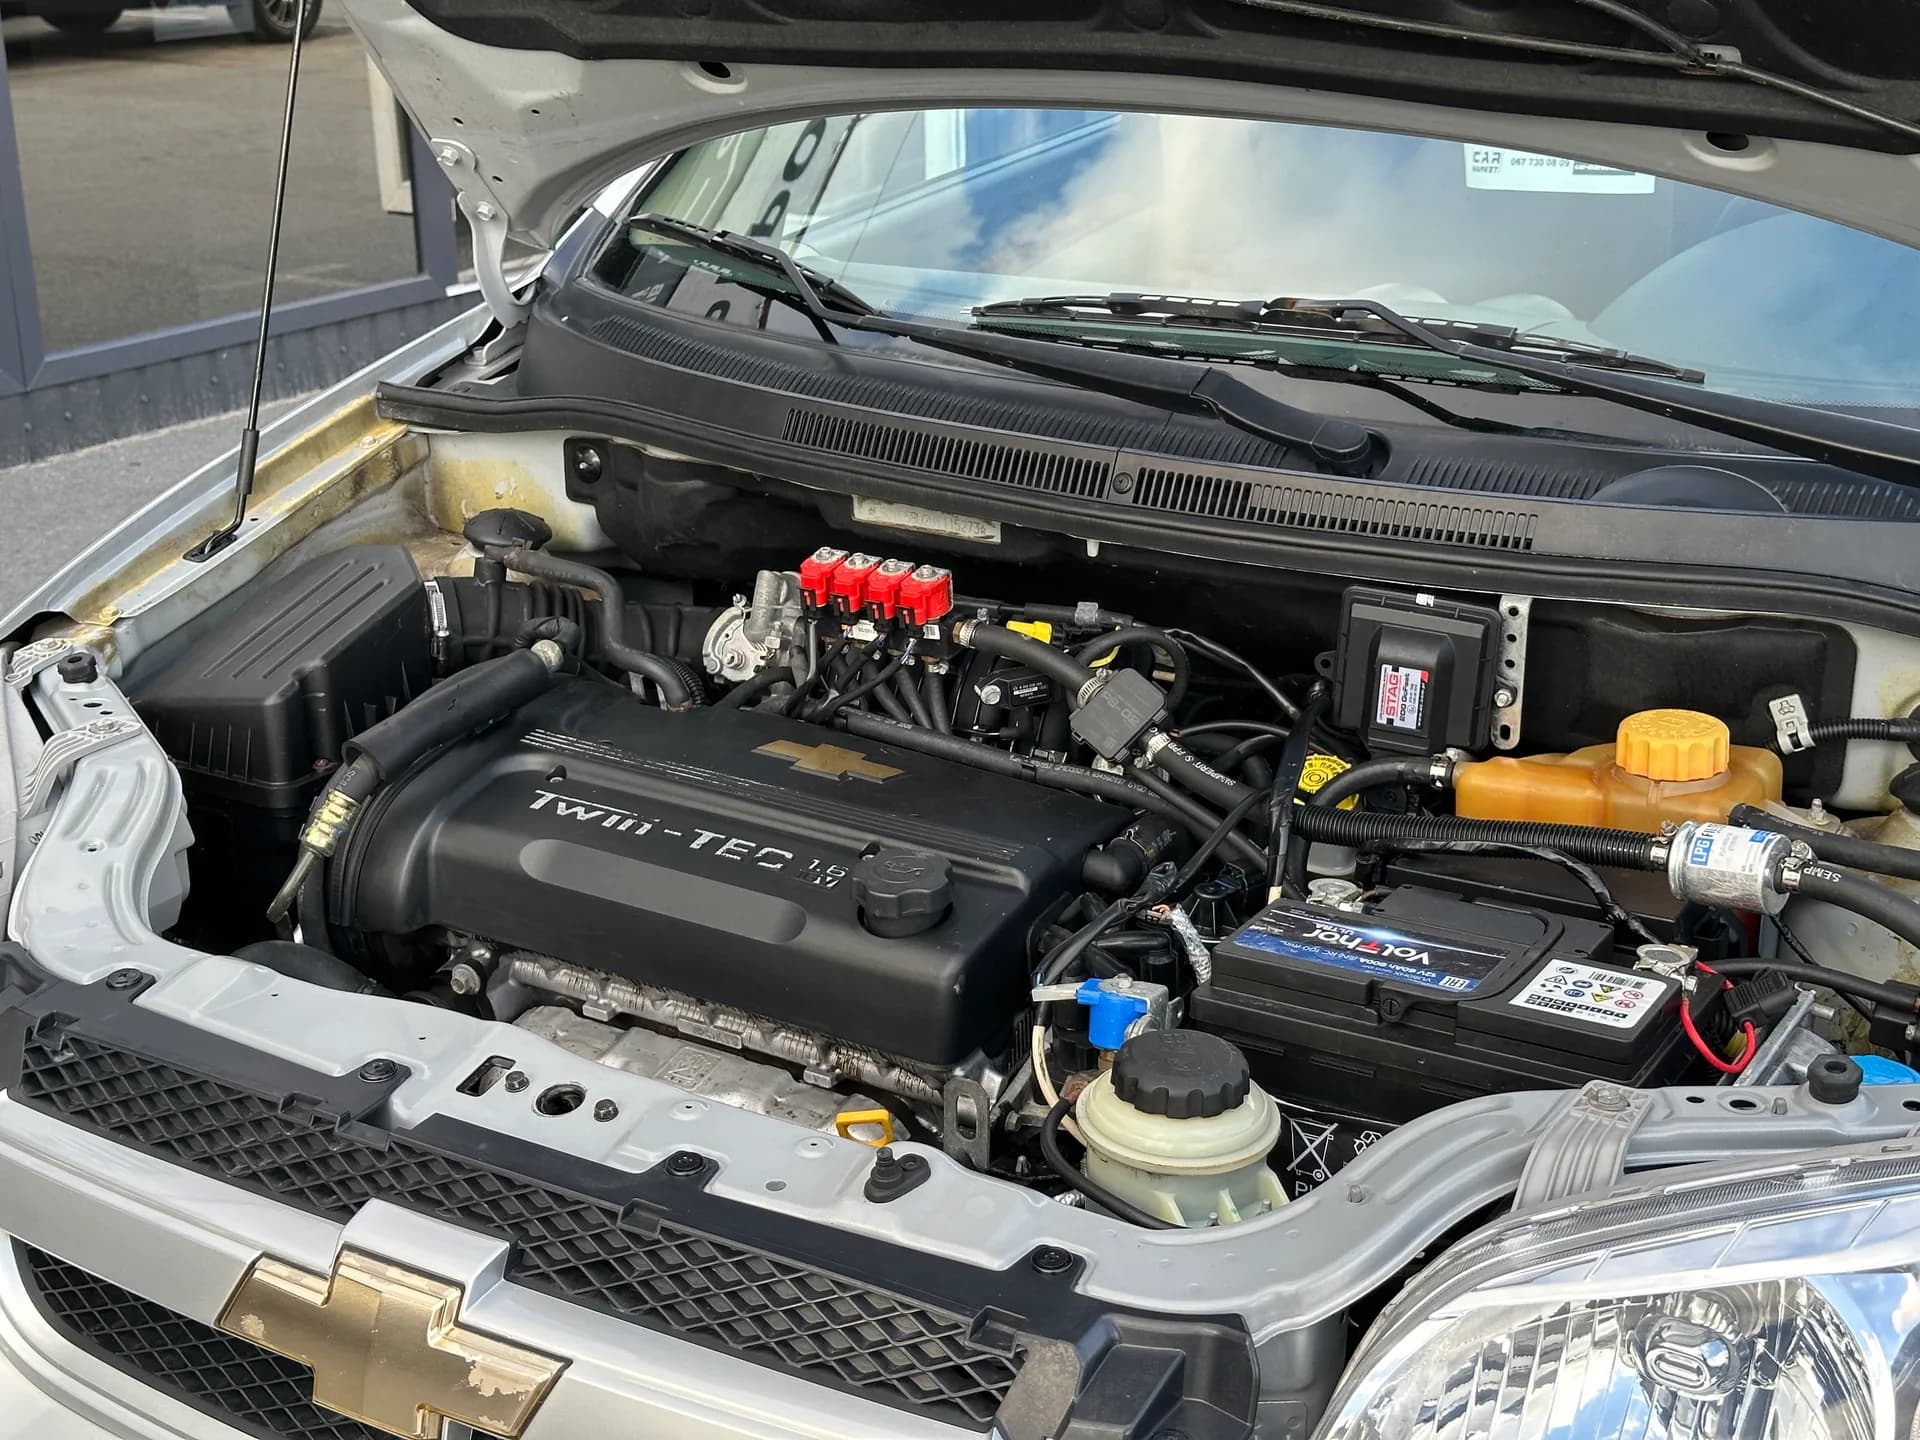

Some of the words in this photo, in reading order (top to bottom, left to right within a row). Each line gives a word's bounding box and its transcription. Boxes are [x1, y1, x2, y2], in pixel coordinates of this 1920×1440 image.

[1472, 151, 1500, 163] CAR
[1510, 158, 1526, 166] 067
[1529, 158, 1544, 166] 730
[1546, 158, 1556, 167] 08
[1559, 159, 1570, 167] 09
[1386, 673, 1399, 717] STAG
[1193, 761, 1236, 787] SEMPERIT
[1692, 839, 1712, 864] LPG
[808, 857, 849, 879] 1.6
[1803, 865, 1842, 883] SEMP
[1313, 923, 1353, 937] ULTRA
[1303, 928, 1430, 966] VolThor
[1359, 957, 1390, 969] 600A
[1390, 963, 1416, 974] 60Ah
[1416, 970, 1436, 979] 12V
